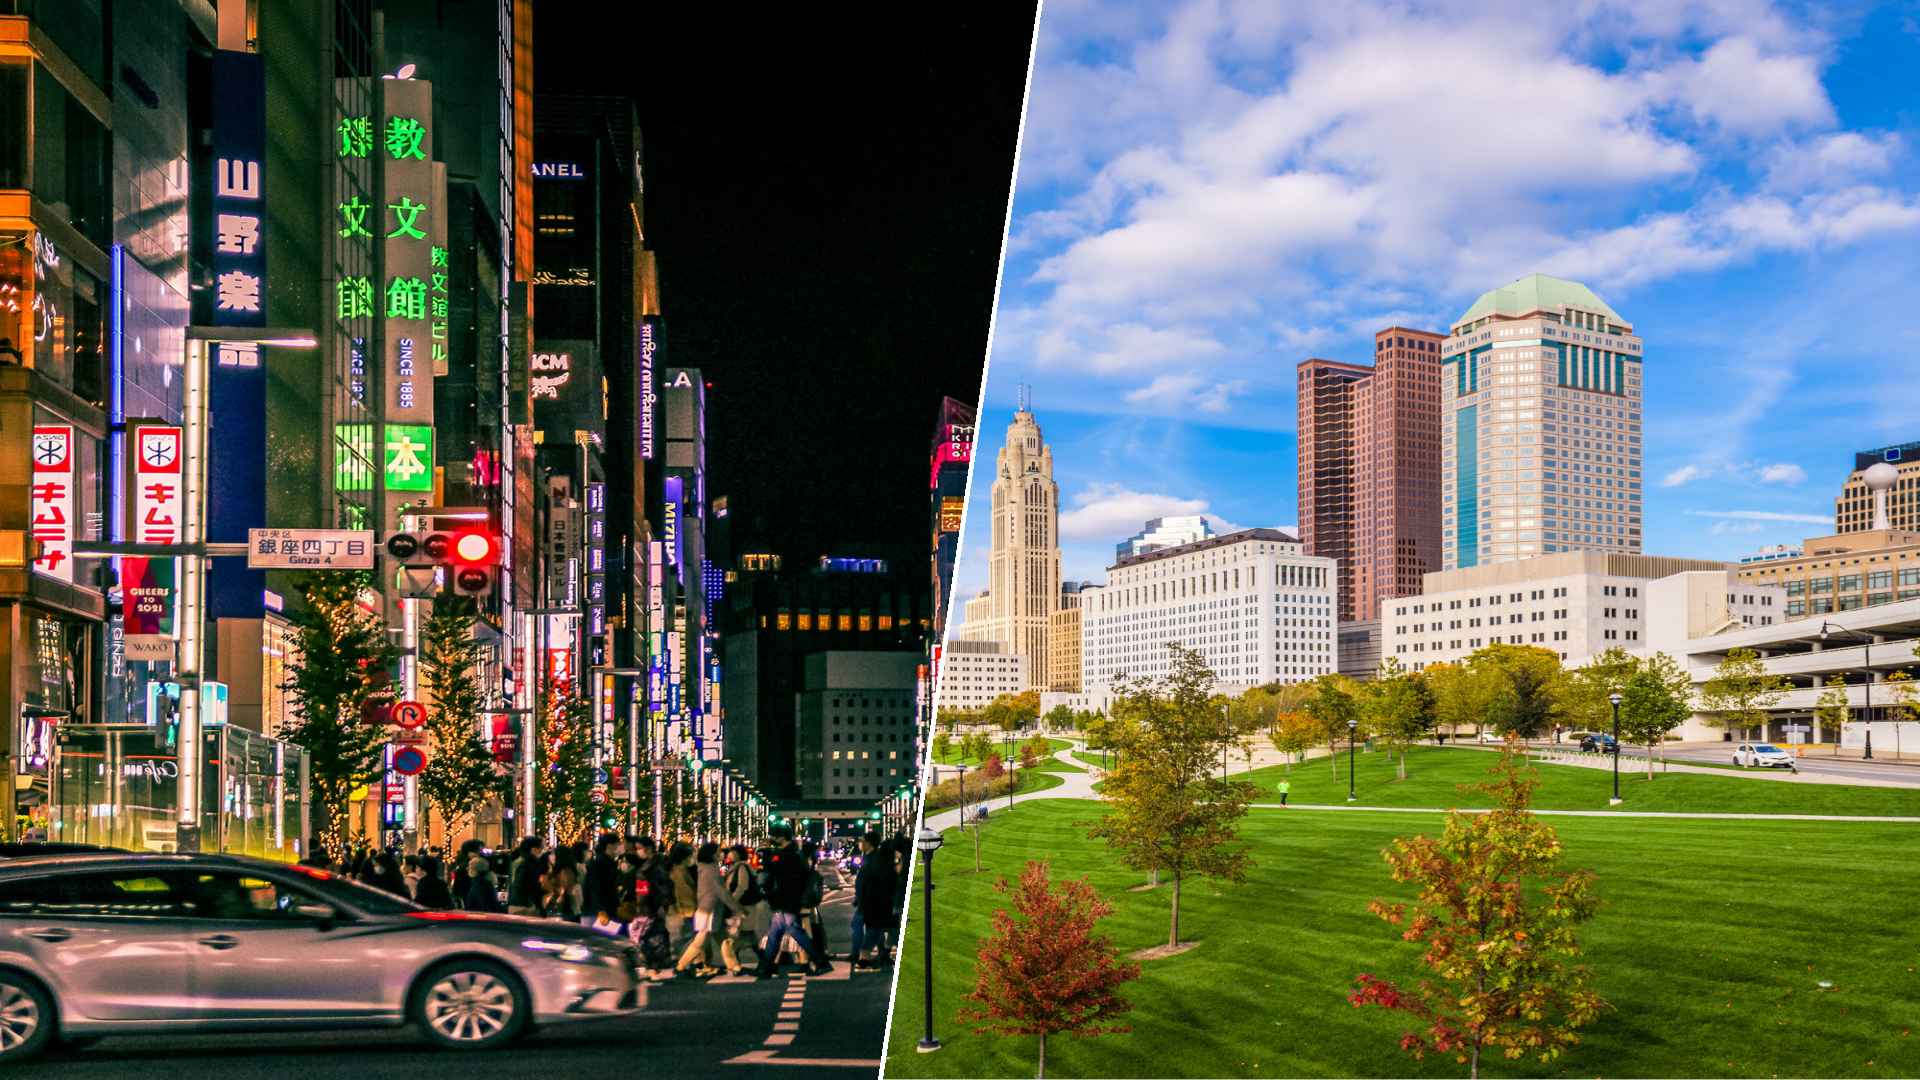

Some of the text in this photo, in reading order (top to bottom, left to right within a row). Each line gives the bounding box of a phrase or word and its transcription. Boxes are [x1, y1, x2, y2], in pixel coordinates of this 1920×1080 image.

[384, 116, 427, 319] 教文館
[432, 246, 448, 360] 教文館ビル
[400, 338, 413, 408] SINCE 1885
[387, 436, 426, 480] 本
[258, 530, 290, 538] 中央区
[258, 539, 364, 555] 銀座四丁目
[289, 555, 331, 564] Ginza 4
[130, 588, 169, 596] CHEERS
[137, 604, 162, 612] 2021
